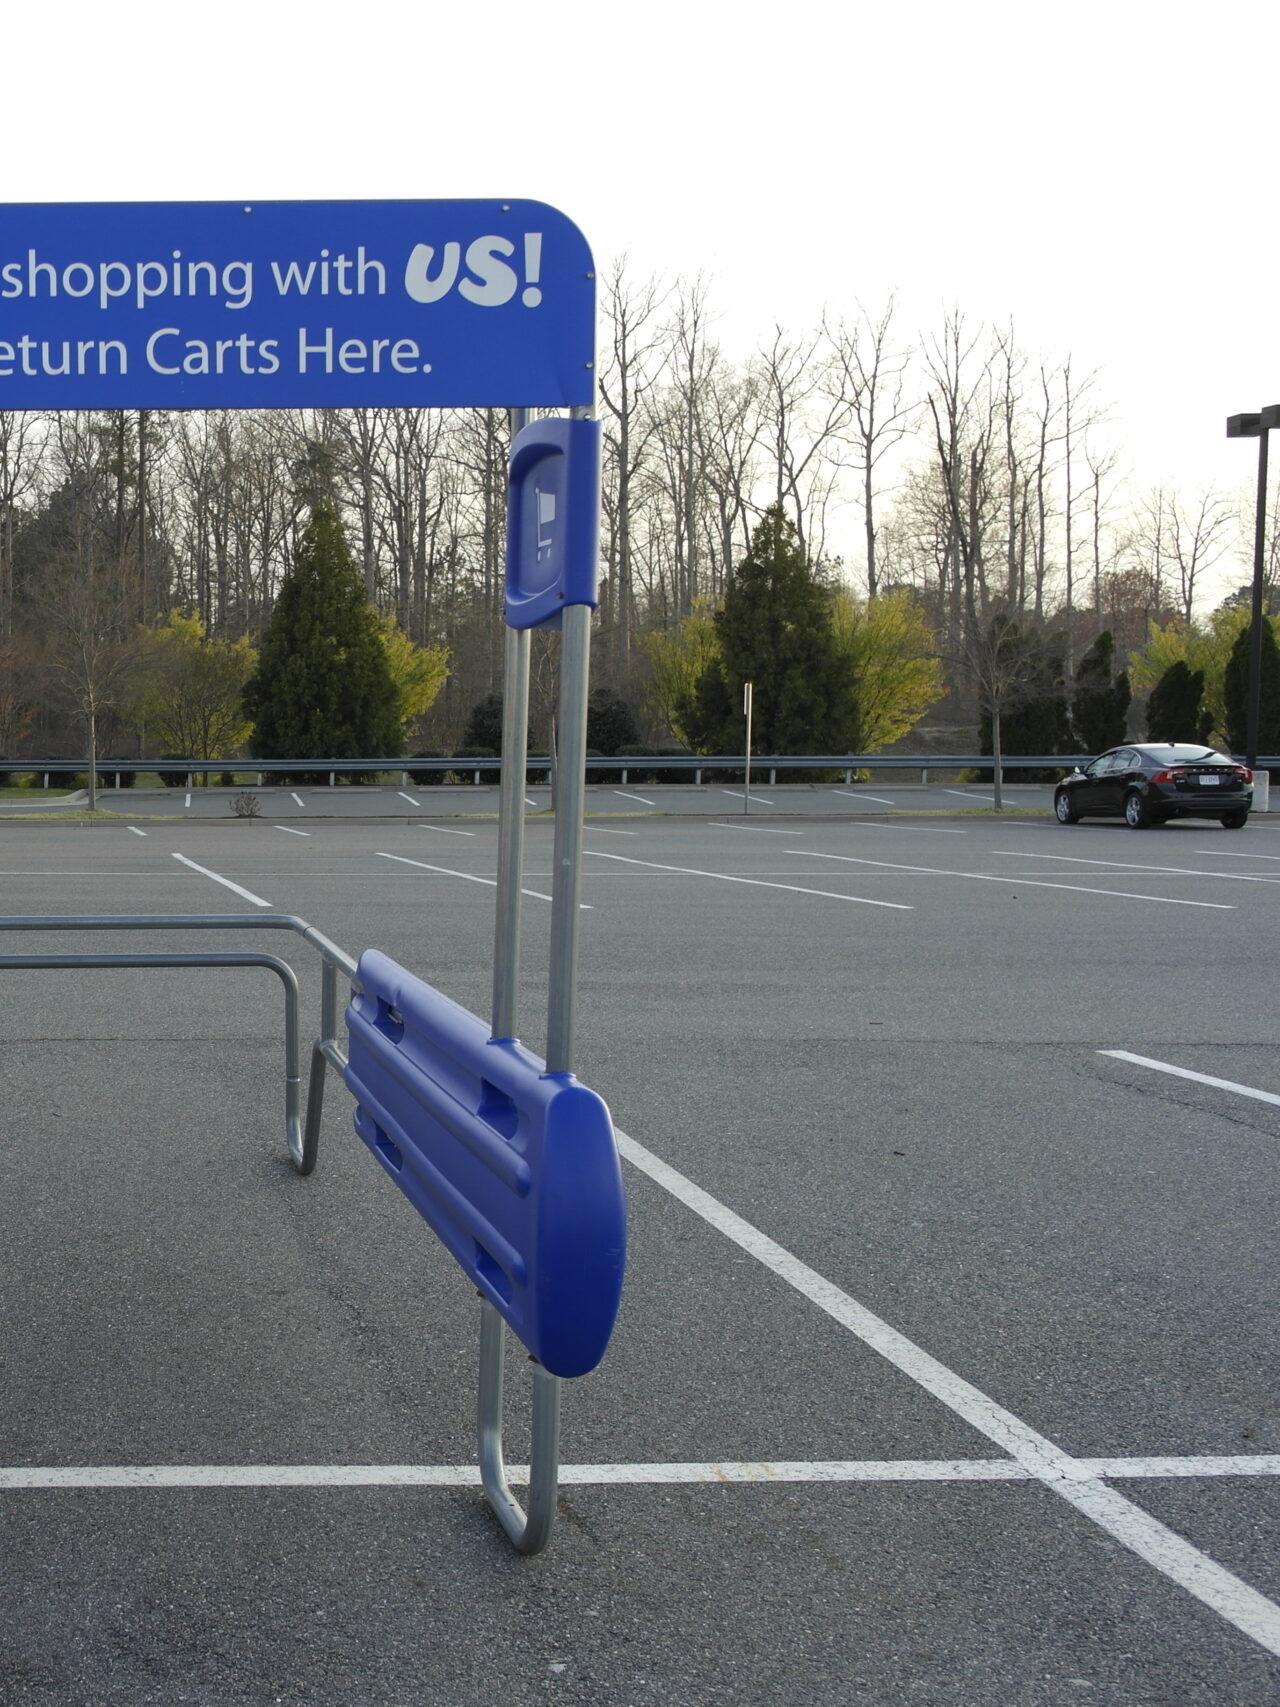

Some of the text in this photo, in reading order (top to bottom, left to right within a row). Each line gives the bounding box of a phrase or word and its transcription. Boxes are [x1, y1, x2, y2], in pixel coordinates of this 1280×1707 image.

[1, 248, 253, 308] shopping
[270, 247, 386, 296] with
[404, 232, 543, 308] US!
[146, 328, 280, 375] Carts
[299, 327, 432, 374] Here.
